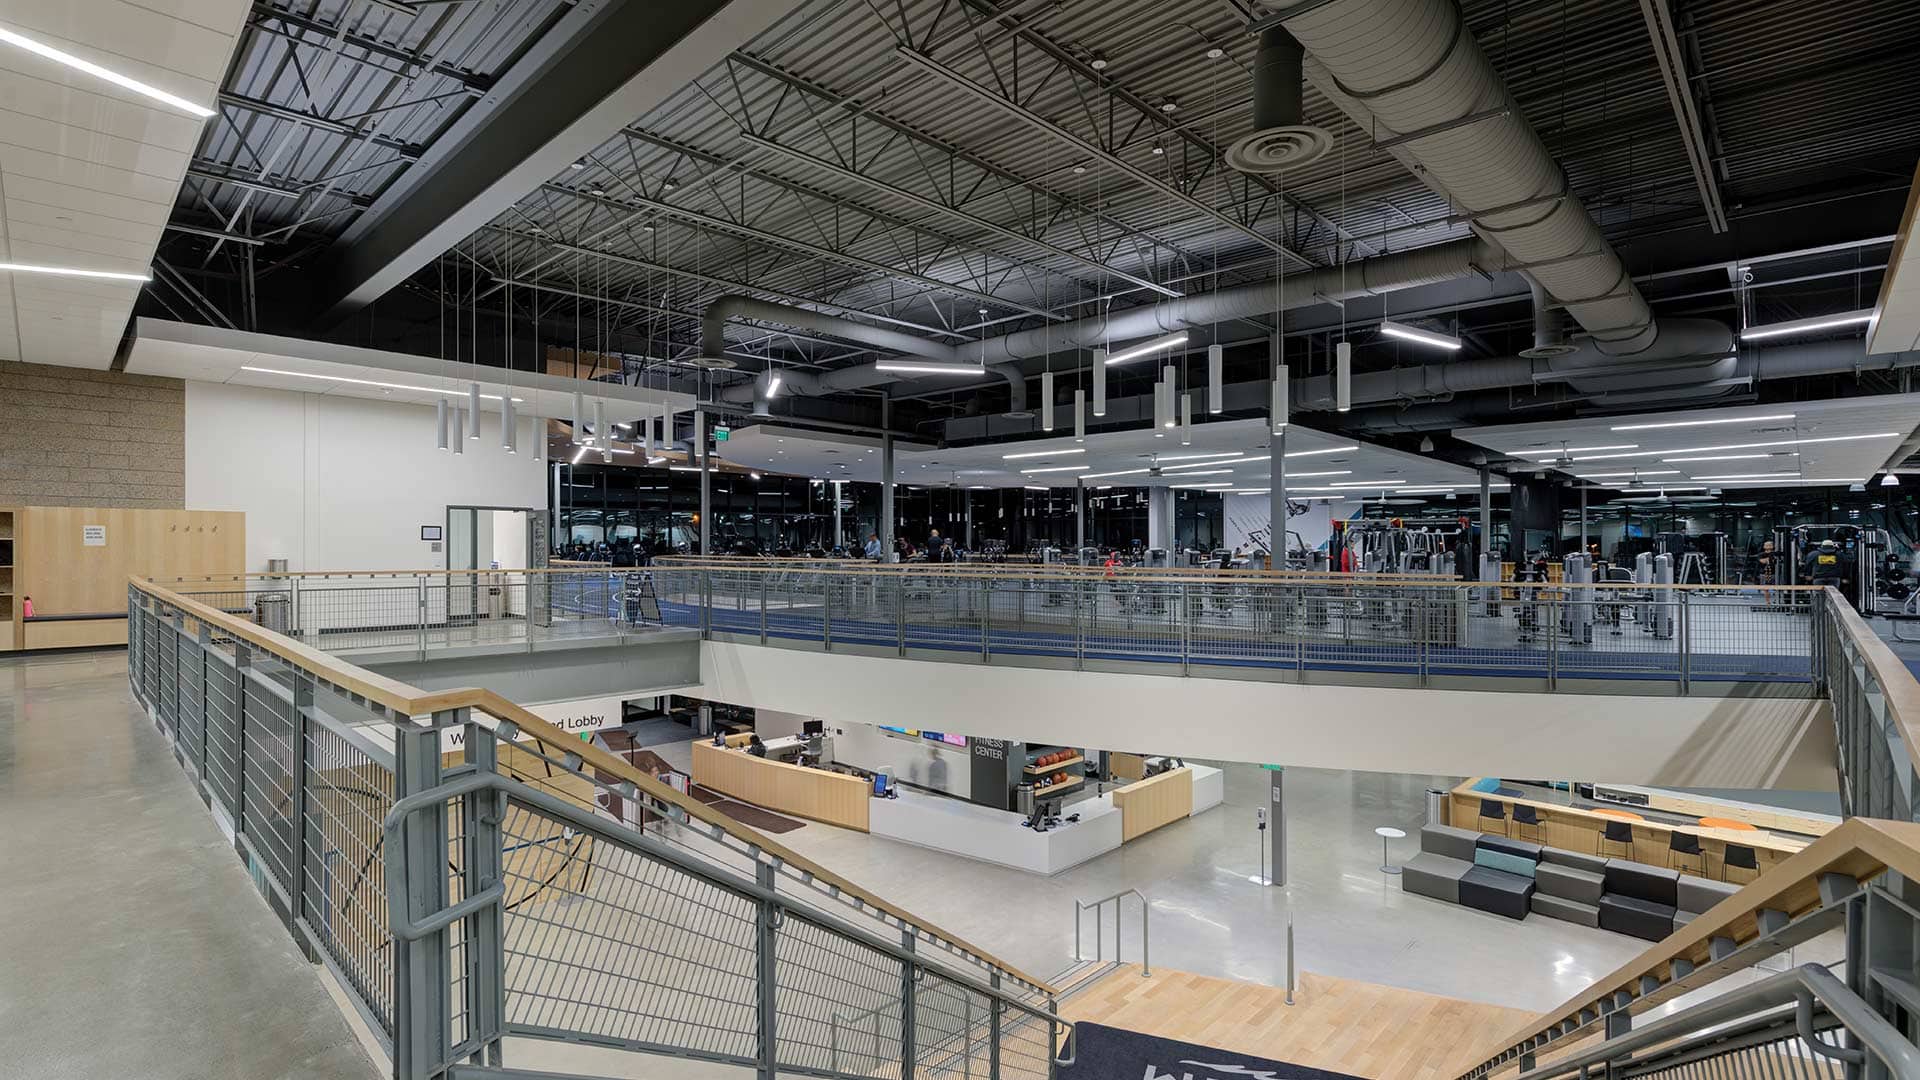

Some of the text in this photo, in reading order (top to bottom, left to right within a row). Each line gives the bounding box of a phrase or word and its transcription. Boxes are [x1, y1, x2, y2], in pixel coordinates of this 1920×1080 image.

[568, 715, 605, 729] Lobby
[975, 736, 1004, 752] FITNESS
[975, 745, 1004, 761] CENTER
